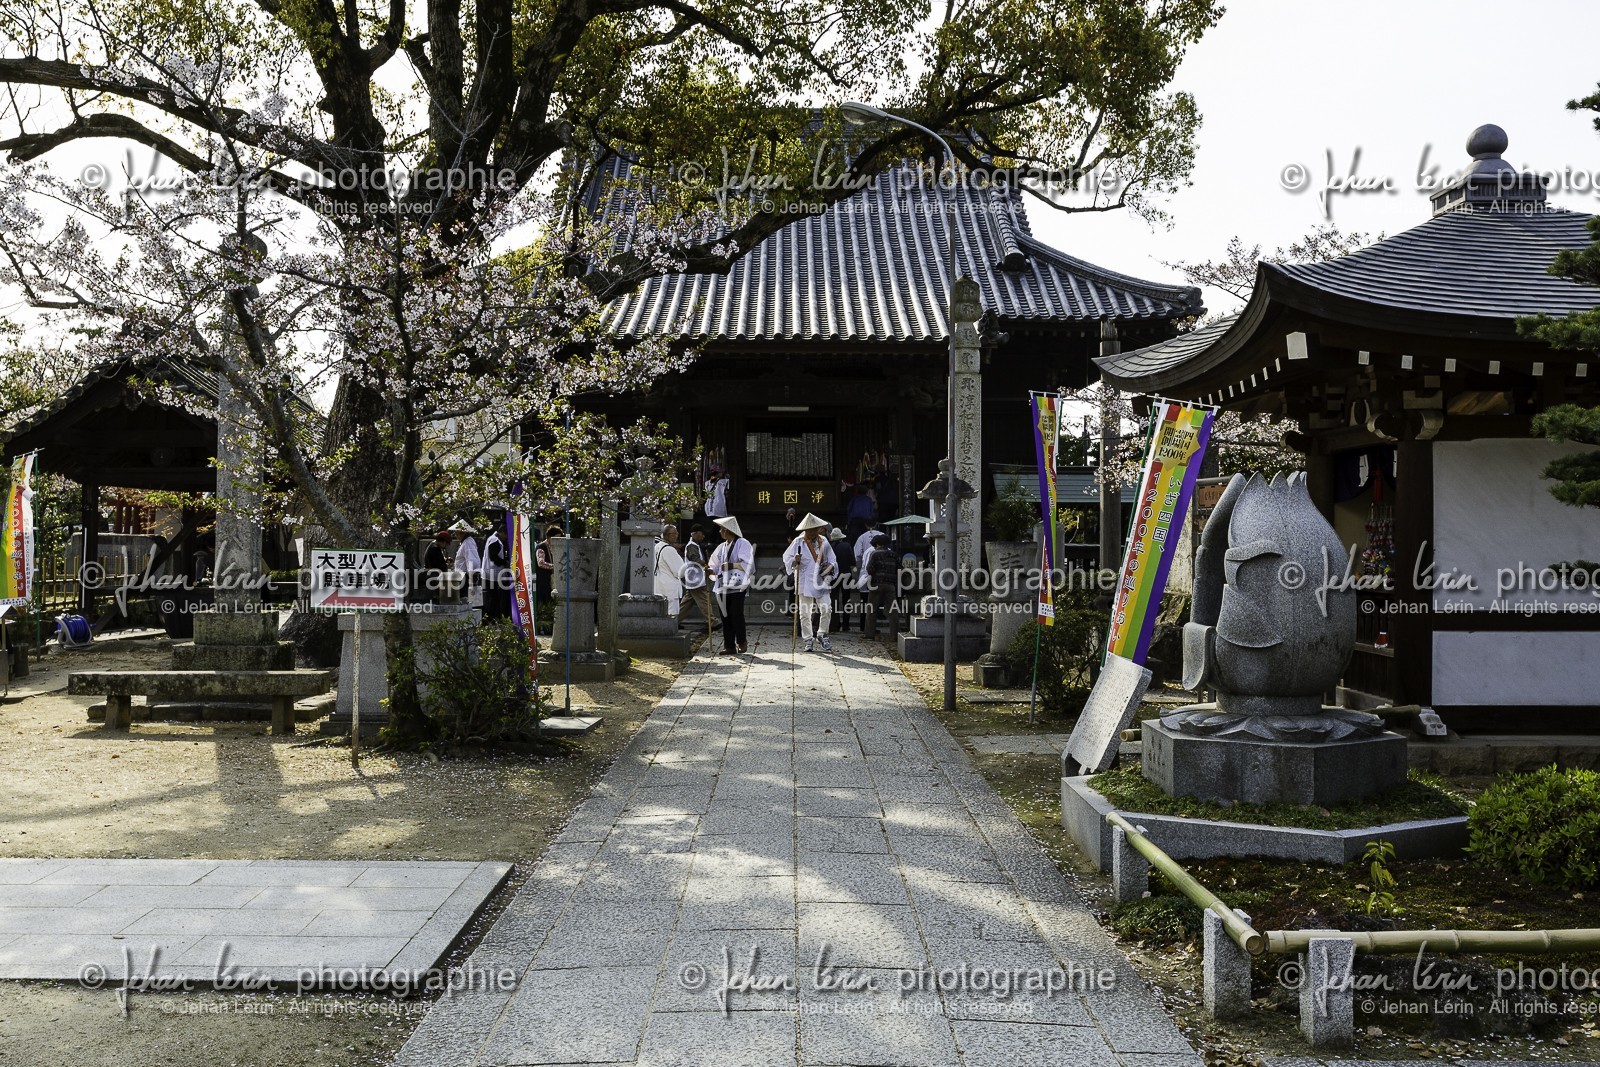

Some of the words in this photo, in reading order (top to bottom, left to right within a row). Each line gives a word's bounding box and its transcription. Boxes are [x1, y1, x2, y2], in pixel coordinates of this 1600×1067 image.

[316, 553, 399, 570] 大型バス
[323, 571, 391, 590] 駐車場
